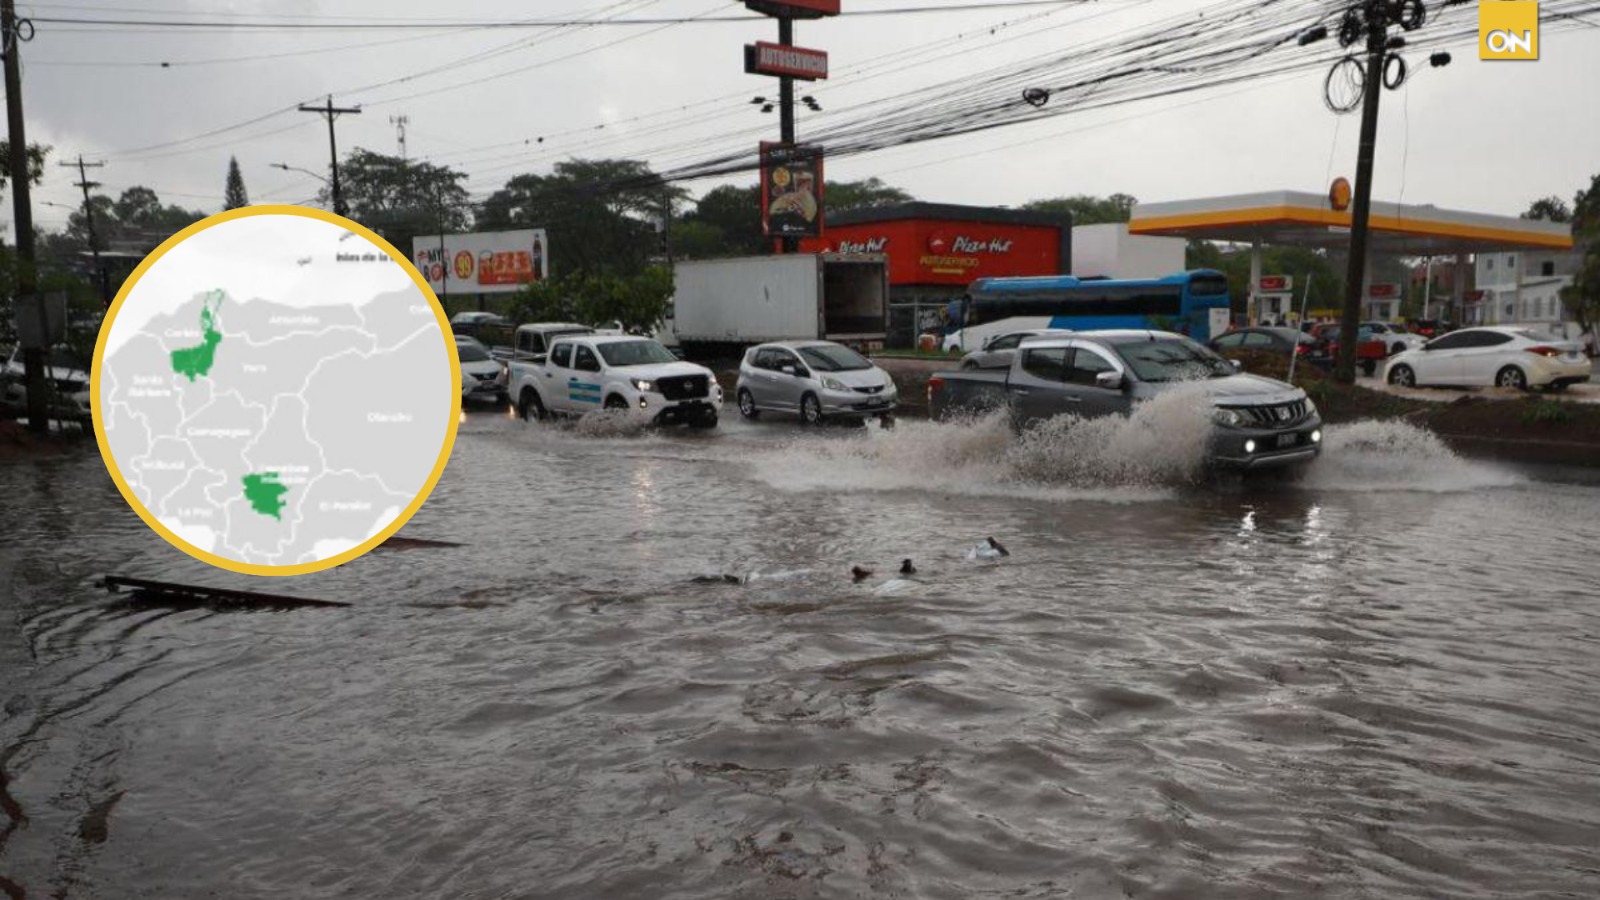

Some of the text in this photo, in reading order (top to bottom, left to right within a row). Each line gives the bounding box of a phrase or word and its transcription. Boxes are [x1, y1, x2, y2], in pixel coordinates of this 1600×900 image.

[760, 47, 826, 73] AUTOSERVICIO
[952, 236, 1014, 253] Pizza Hut
